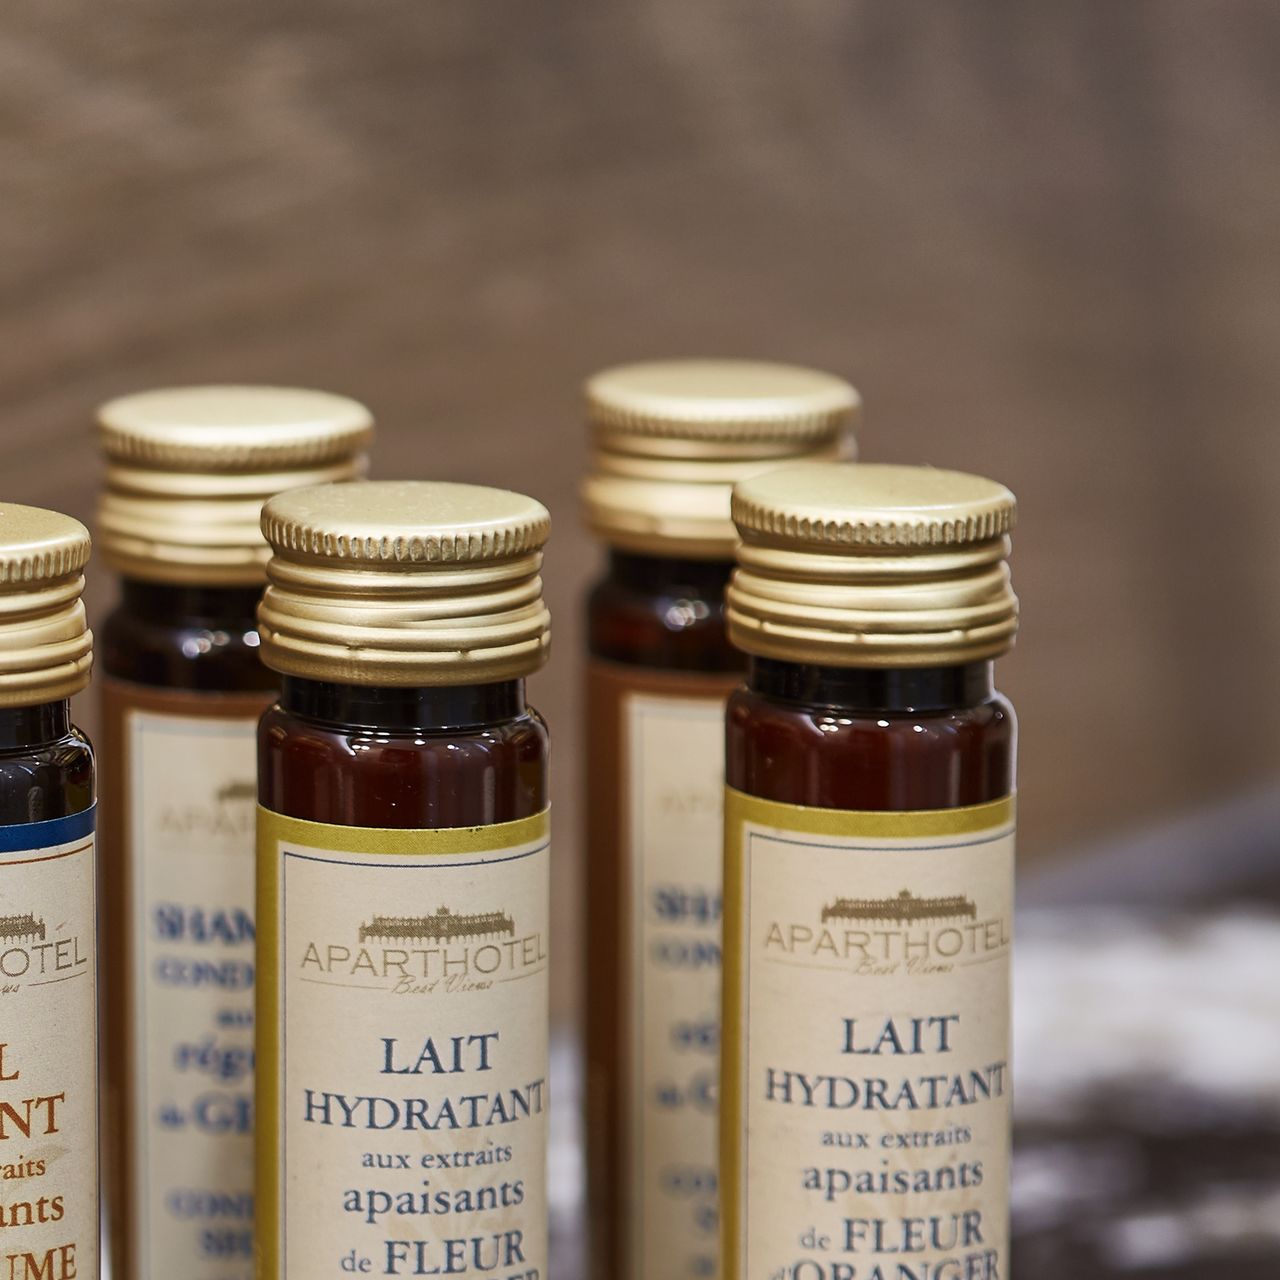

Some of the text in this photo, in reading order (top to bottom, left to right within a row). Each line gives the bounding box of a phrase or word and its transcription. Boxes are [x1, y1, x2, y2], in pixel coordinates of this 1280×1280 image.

[300, 933, 546, 978] APARTHOTEL
[764, 918, 1009, 960] APARTHOTEL
[380, 1032, 499, 1074] LAIT
[841, 1013, 960, 1055] LAIT
[303, 1078, 545, 1131] HYDRATANT
[765, 1061, 1007, 1111] HYDRATANT
[361, 1139, 513, 1169] aux extraits
[821, 1121, 972, 1149] aux extraits
[343, 1179, 524, 1224] apaisants
[802, 1159, 984, 1201] apaisants
[341, 1230, 525, 1276] de FLEUR
[799, 1209, 985, 1254] de FLEUR
